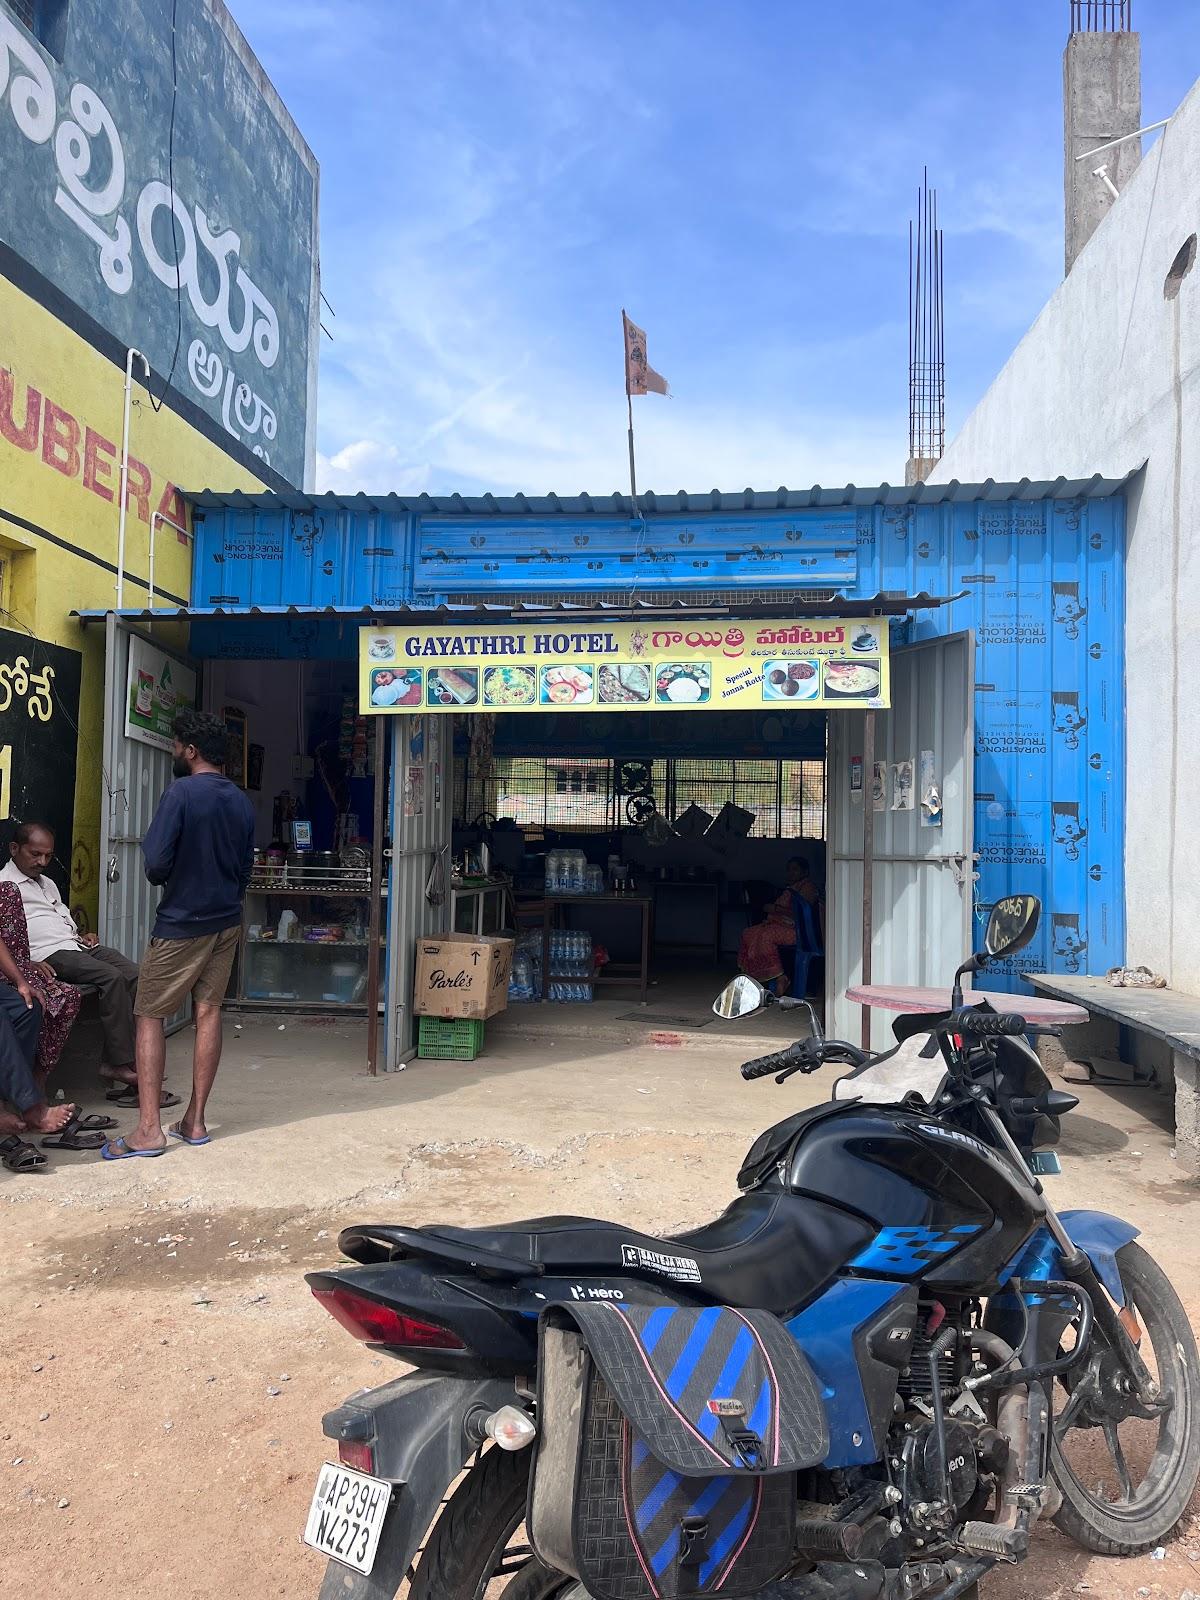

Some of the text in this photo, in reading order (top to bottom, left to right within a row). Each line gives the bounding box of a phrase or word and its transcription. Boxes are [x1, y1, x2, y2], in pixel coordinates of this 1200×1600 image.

[0, 8, 279, 368] ాల్మియా
[405, 633, 619, 657] GAYATHRI HOTEL
[652, 628, 745, 658] గాయిత్రి
[721, 674, 766, 698] Jonna Rotte
[725, 667, 753, 684] Special
[428, 969, 473, 990] Parle's
[918, 1124, 1006, 1168] GLAMO
[588, 1288, 624, 1299] Hero
[889, 1331, 909, 1340] Fi
[325, 1473, 382, 1524] AP39H
[316, 1510, 370, 1563] N4273
